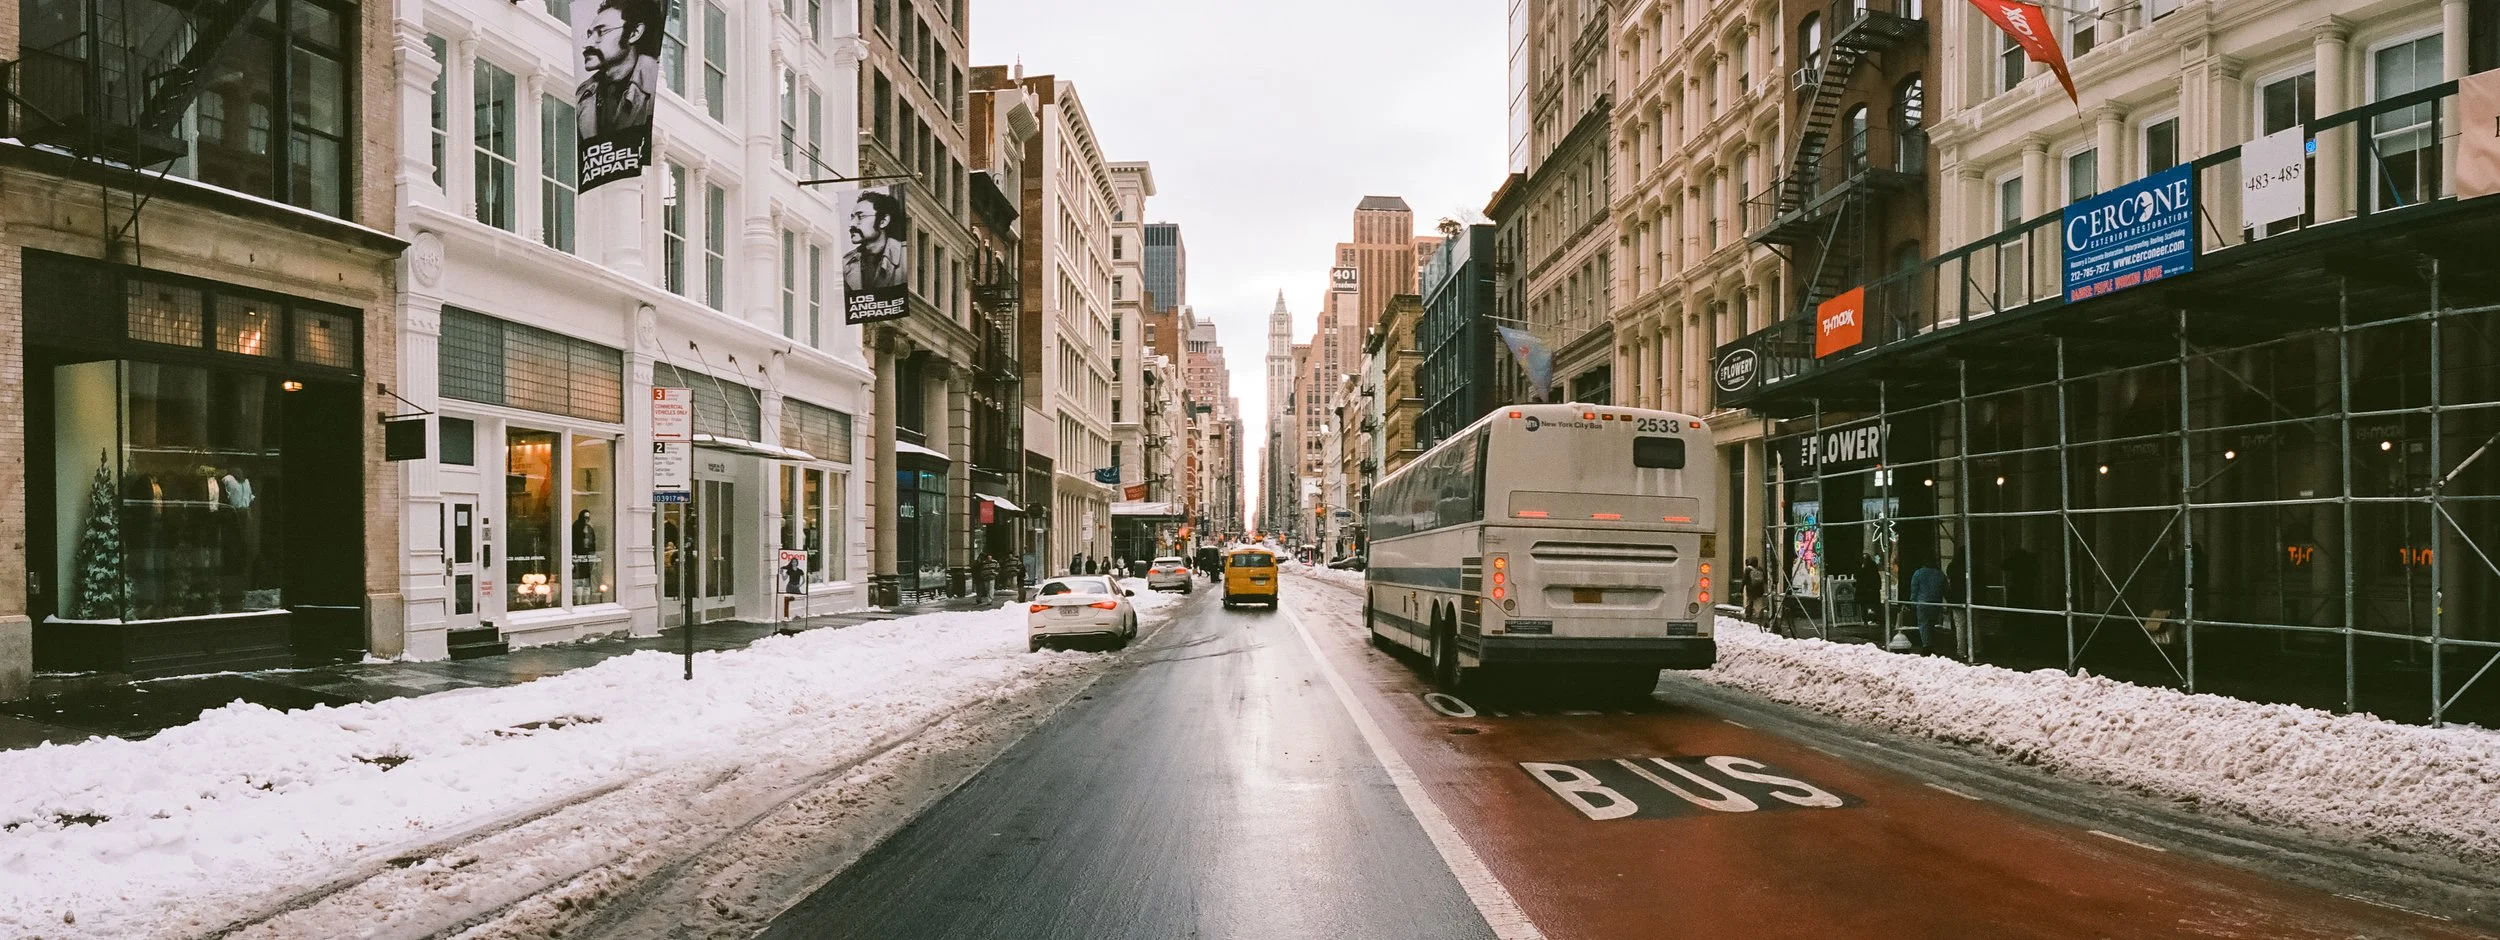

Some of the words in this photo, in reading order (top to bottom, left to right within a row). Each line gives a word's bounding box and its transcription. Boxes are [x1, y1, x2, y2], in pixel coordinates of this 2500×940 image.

[582, 141, 612, 161] LOS
[582, 142, 643, 173] ANGEL
[582, 158, 639, 185] APPAR
[2066, 178, 2189, 251] CERCONE
[2090, 230, 2128, 248] EXTERIOR
[2131, 211, 2188, 235] RESTORATION
[2070, 262, 2110, 281] 212-785-7572
[2113, 240, 2185, 269] www.cerconeer.com
[1333, 269, 1355, 280] 401
[2093, 278, 2113, 295] PEOPLE
[2115, 271, 2141, 290] WORKING
[2142, 265, 2163, 281] ABOVE
[849, 294, 875, 304] LOS
[849, 297, 905, 312] ANGELES
[849, 306, 905, 320] APPAREL
[1723, 356, 1754, 380] FLOWERY
[656, 389, 663, 400] 3
[1574, 421, 1588, 430] City
[1637, 418, 1680, 433] 2533
[656, 443, 663, 453] 2
[781, 551, 805, 561] Open
[1520, 756, 1843, 820] BUS
